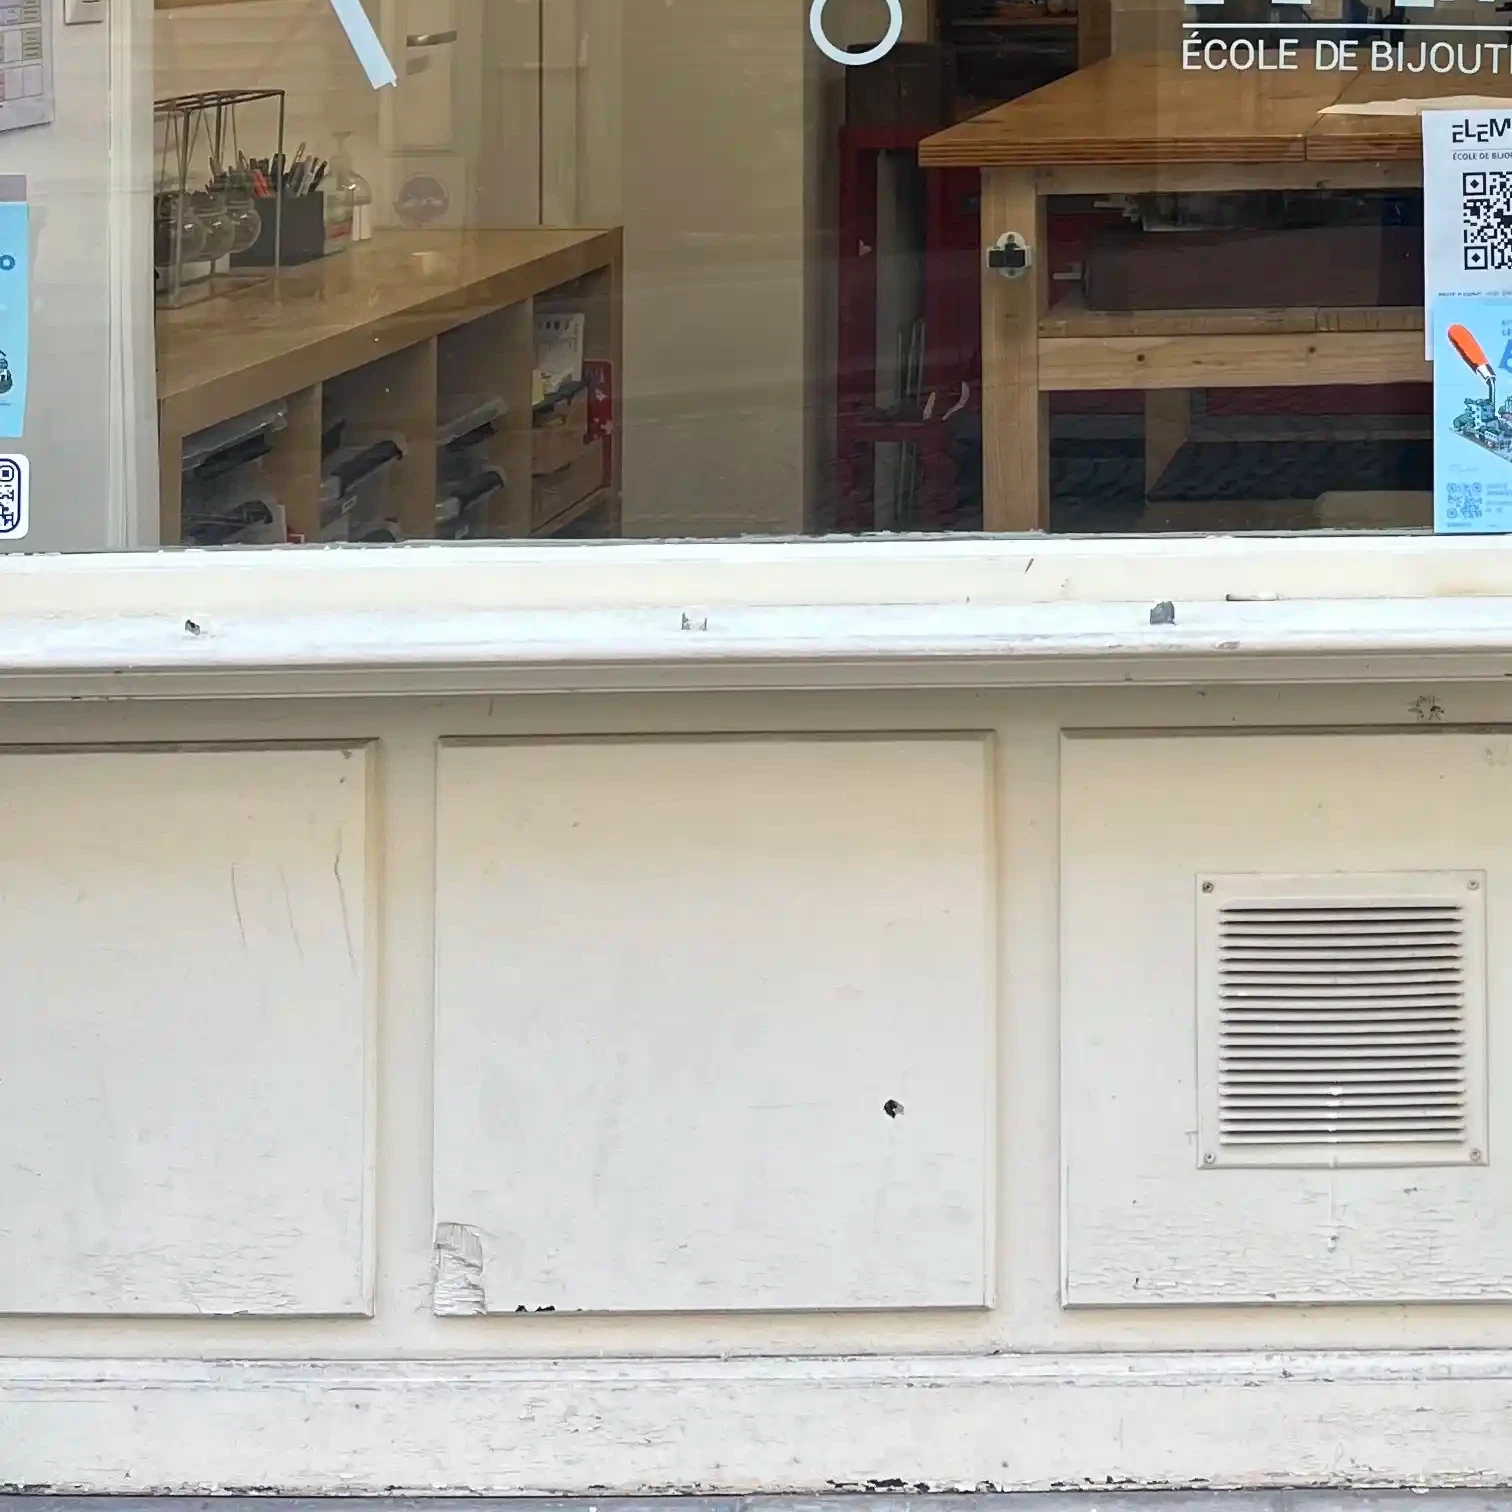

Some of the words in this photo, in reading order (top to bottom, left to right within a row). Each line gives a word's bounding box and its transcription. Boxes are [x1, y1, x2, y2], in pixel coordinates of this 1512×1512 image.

[1182, 31, 1299, 71] ÉCOLE
[1315, 39, 1359, 72] DE
[1479, 151, 1489, 160] DE
